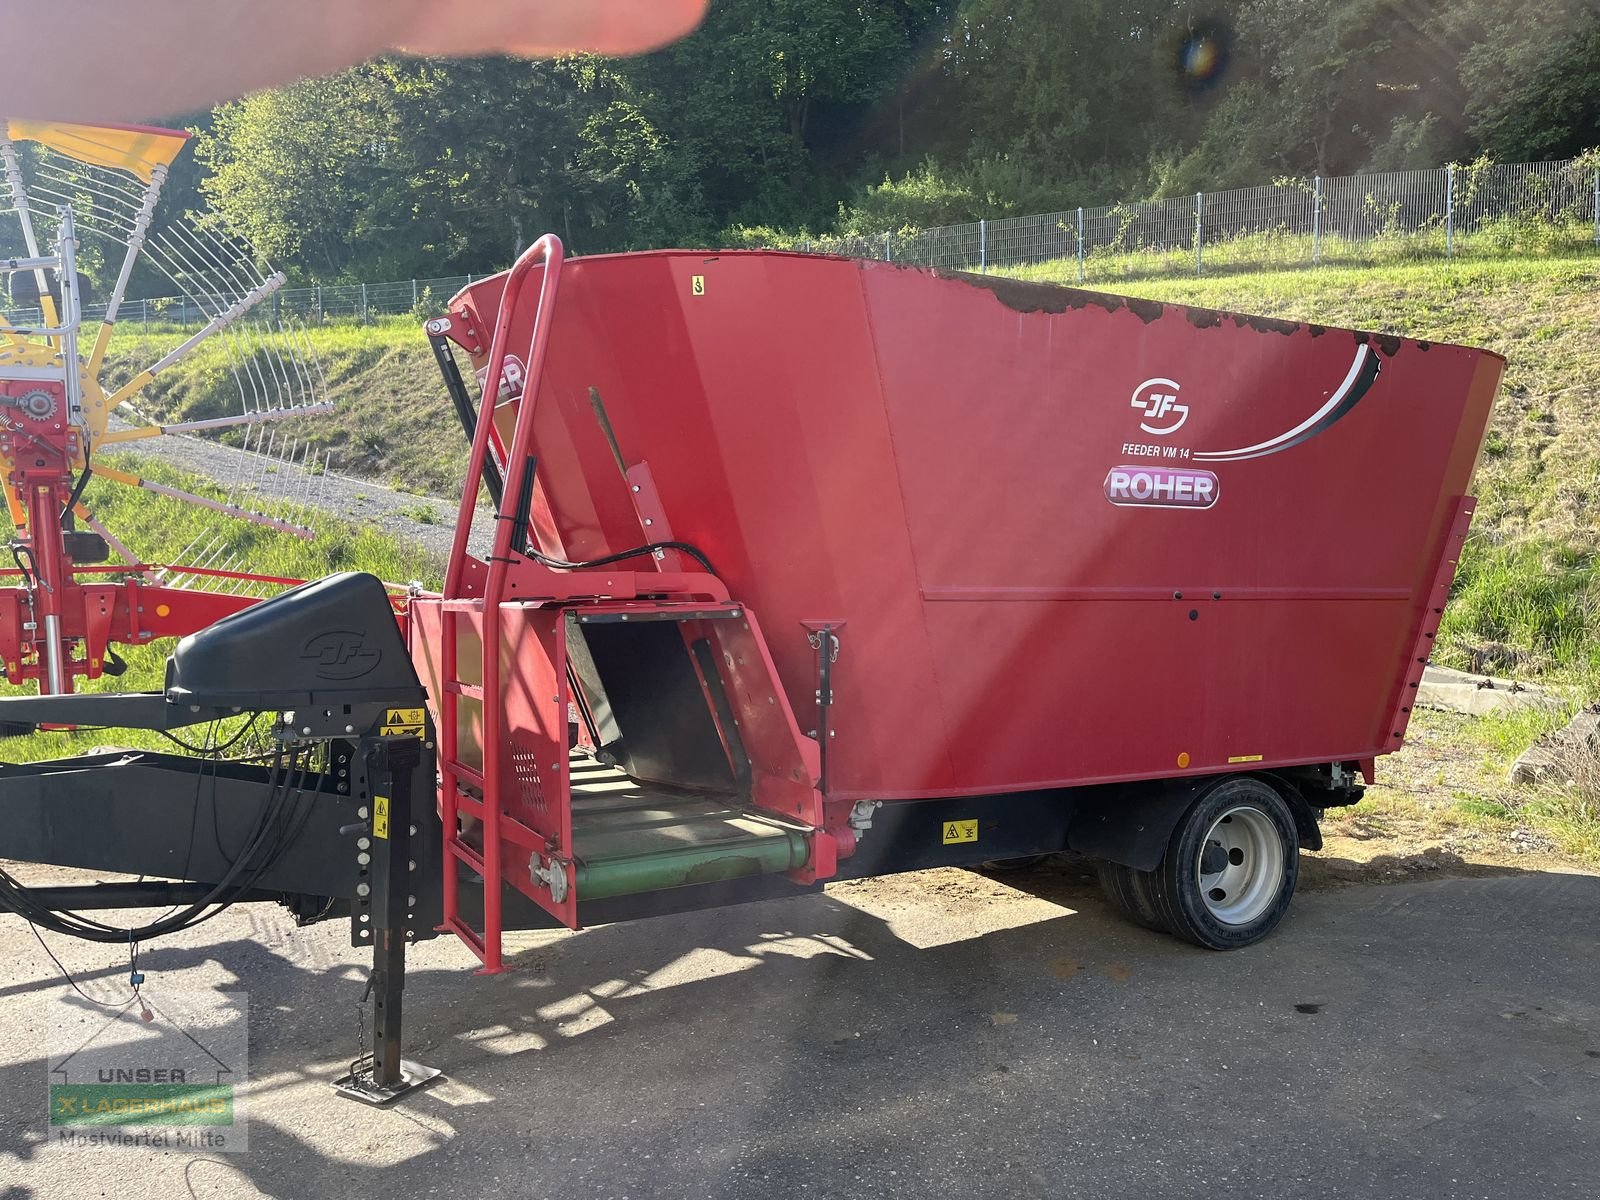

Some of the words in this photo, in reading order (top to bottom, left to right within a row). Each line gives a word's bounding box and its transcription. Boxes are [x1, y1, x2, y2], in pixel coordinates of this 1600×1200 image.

[1122, 443, 1160, 457] FEEDER
[1163, 446, 1177, 458] VM
[1179, 448, 1190, 459] 14
[1110, 472, 1213, 502] ROHER
